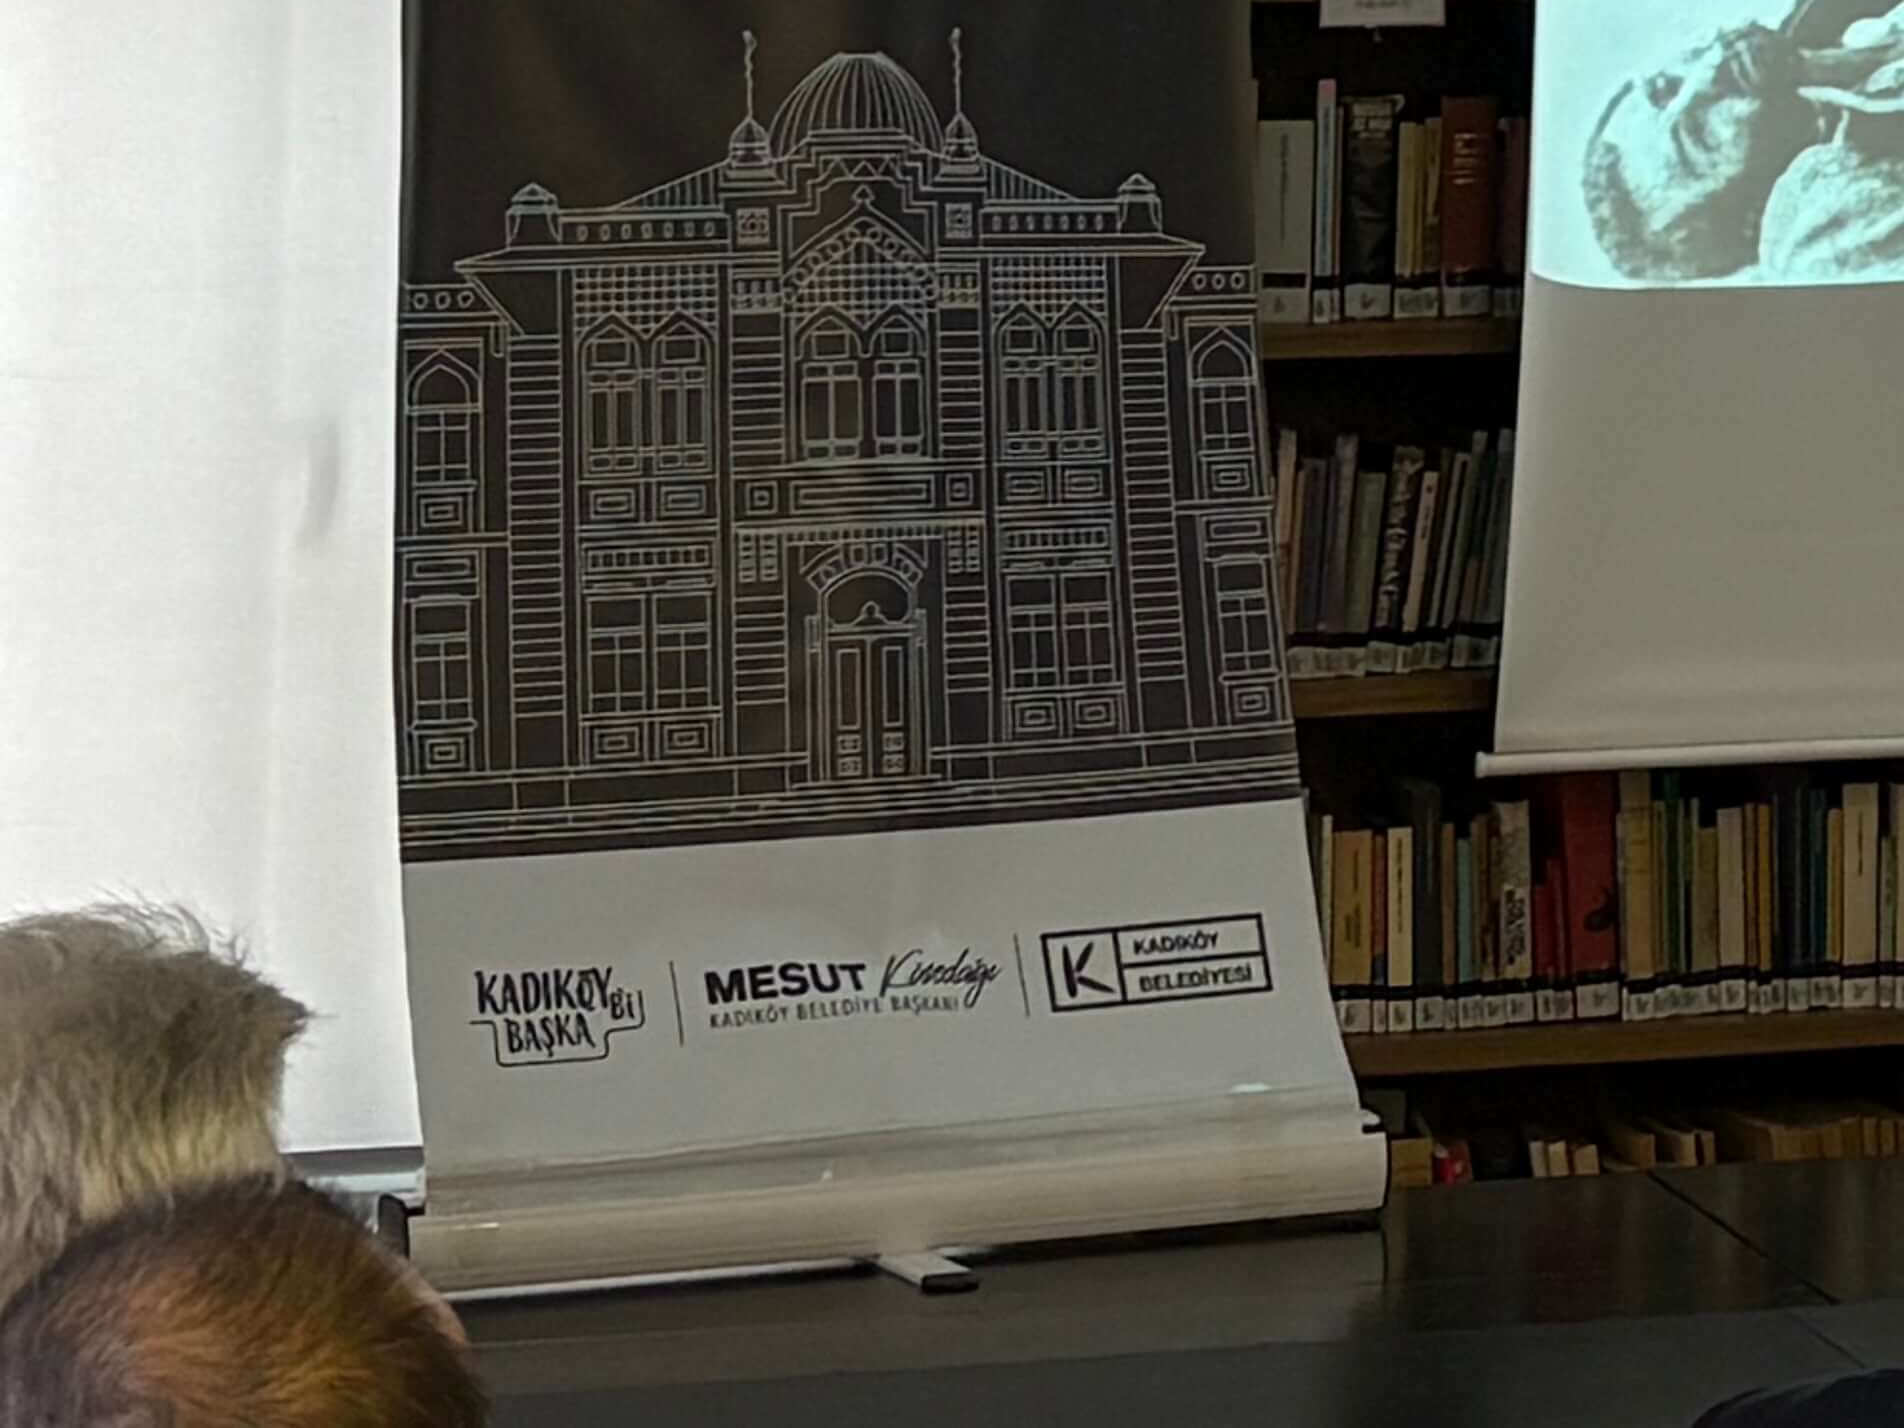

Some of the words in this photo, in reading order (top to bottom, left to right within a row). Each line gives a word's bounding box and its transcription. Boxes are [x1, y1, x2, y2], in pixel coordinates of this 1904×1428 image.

[1133, 930, 1220, 956] KADIKÖY
[703, 961, 867, 1005] MESUT
[1139, 963, 1253, 994] BELEDİYESİ
[709, 1004, 790, 1030] KADIKÖY
[796, 996, 882, 1022] BELEDİYE
[889, 995, 960, 1017] BAŞKANI
[503, 1012, 596, 1058] BAŞKA
